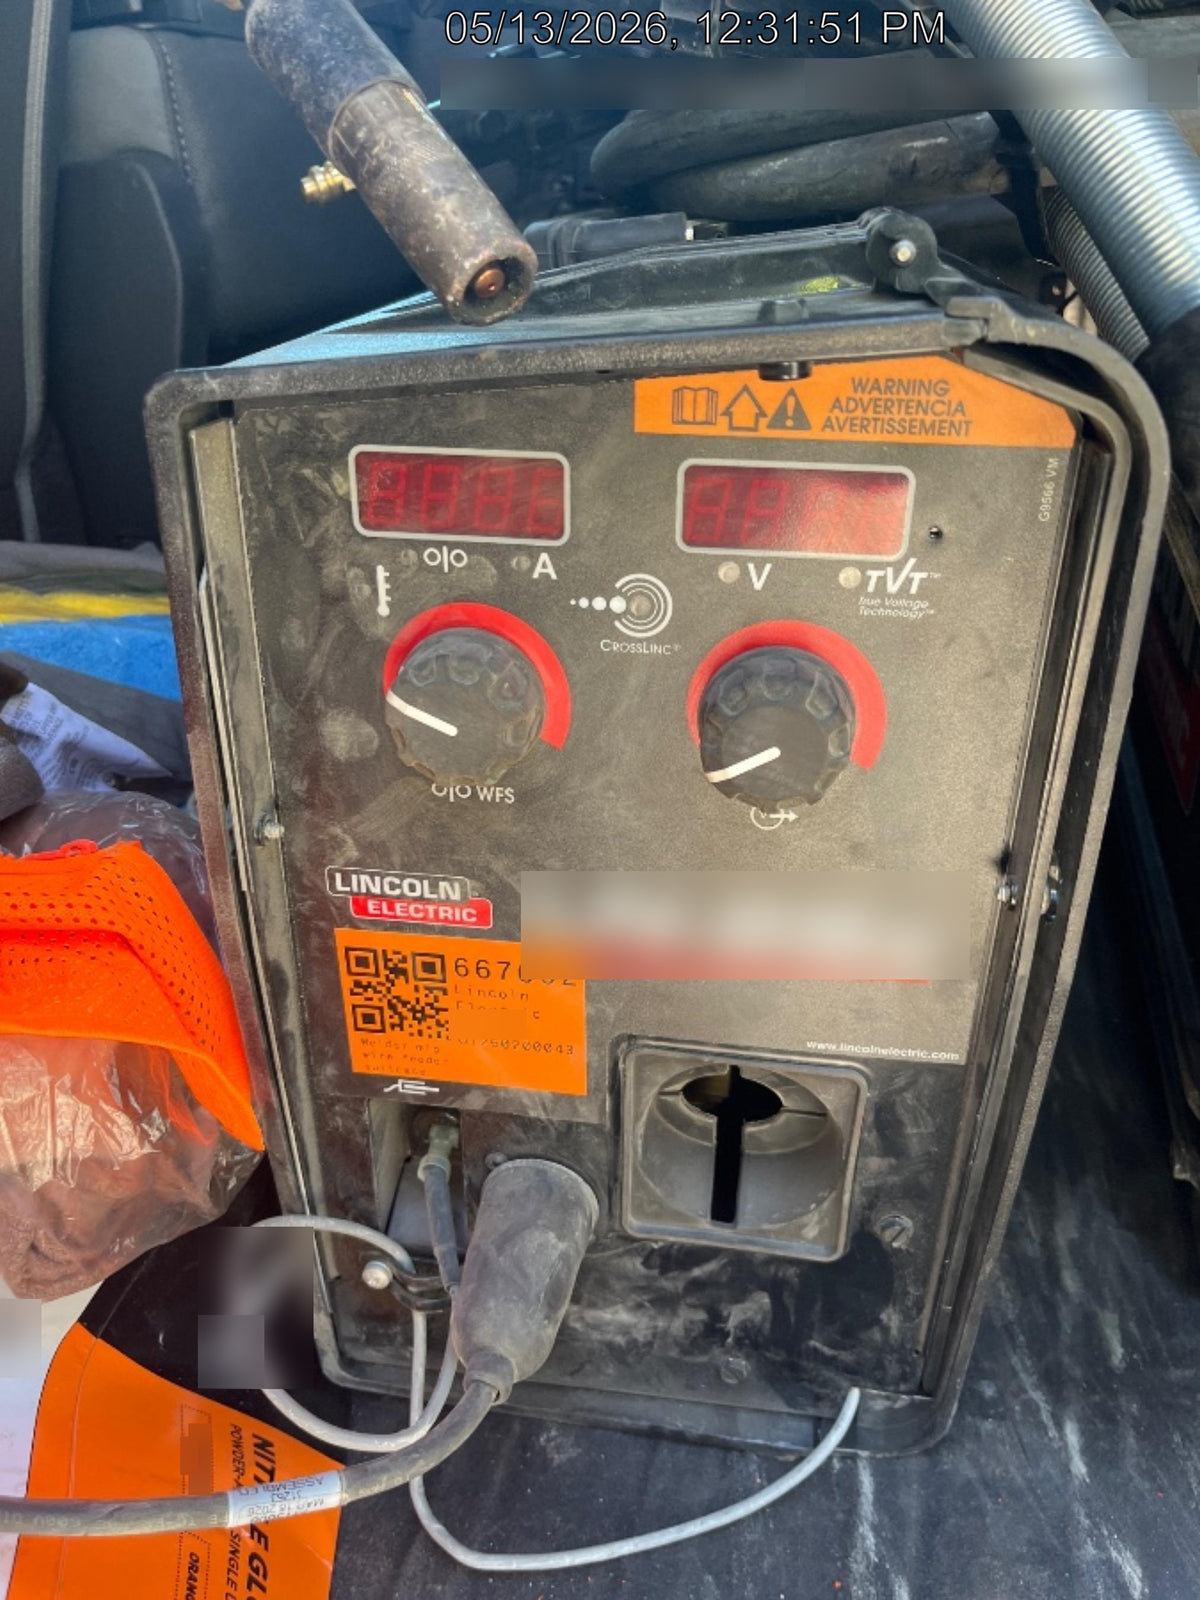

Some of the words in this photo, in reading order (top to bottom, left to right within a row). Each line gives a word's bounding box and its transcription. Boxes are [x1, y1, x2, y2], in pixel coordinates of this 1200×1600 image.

[851, 377, 951, 397] WARNING
[829, 398, 967, 418] ADVERTENCIA
[821, 417, 973, 437] AVERTISSEMENT
[532, 553, 557, 580] A
[747, 563, 772, 591] V
[476, 784, 515, 804] WFS
[334, 872, 461, 901] LINCOLN
[366, 899, 478, 923] ELECTRIC
[806, 1041, 960, 1060] www.lincolnelectric.com
[226, 1530, 242, 1591] SINGLE
